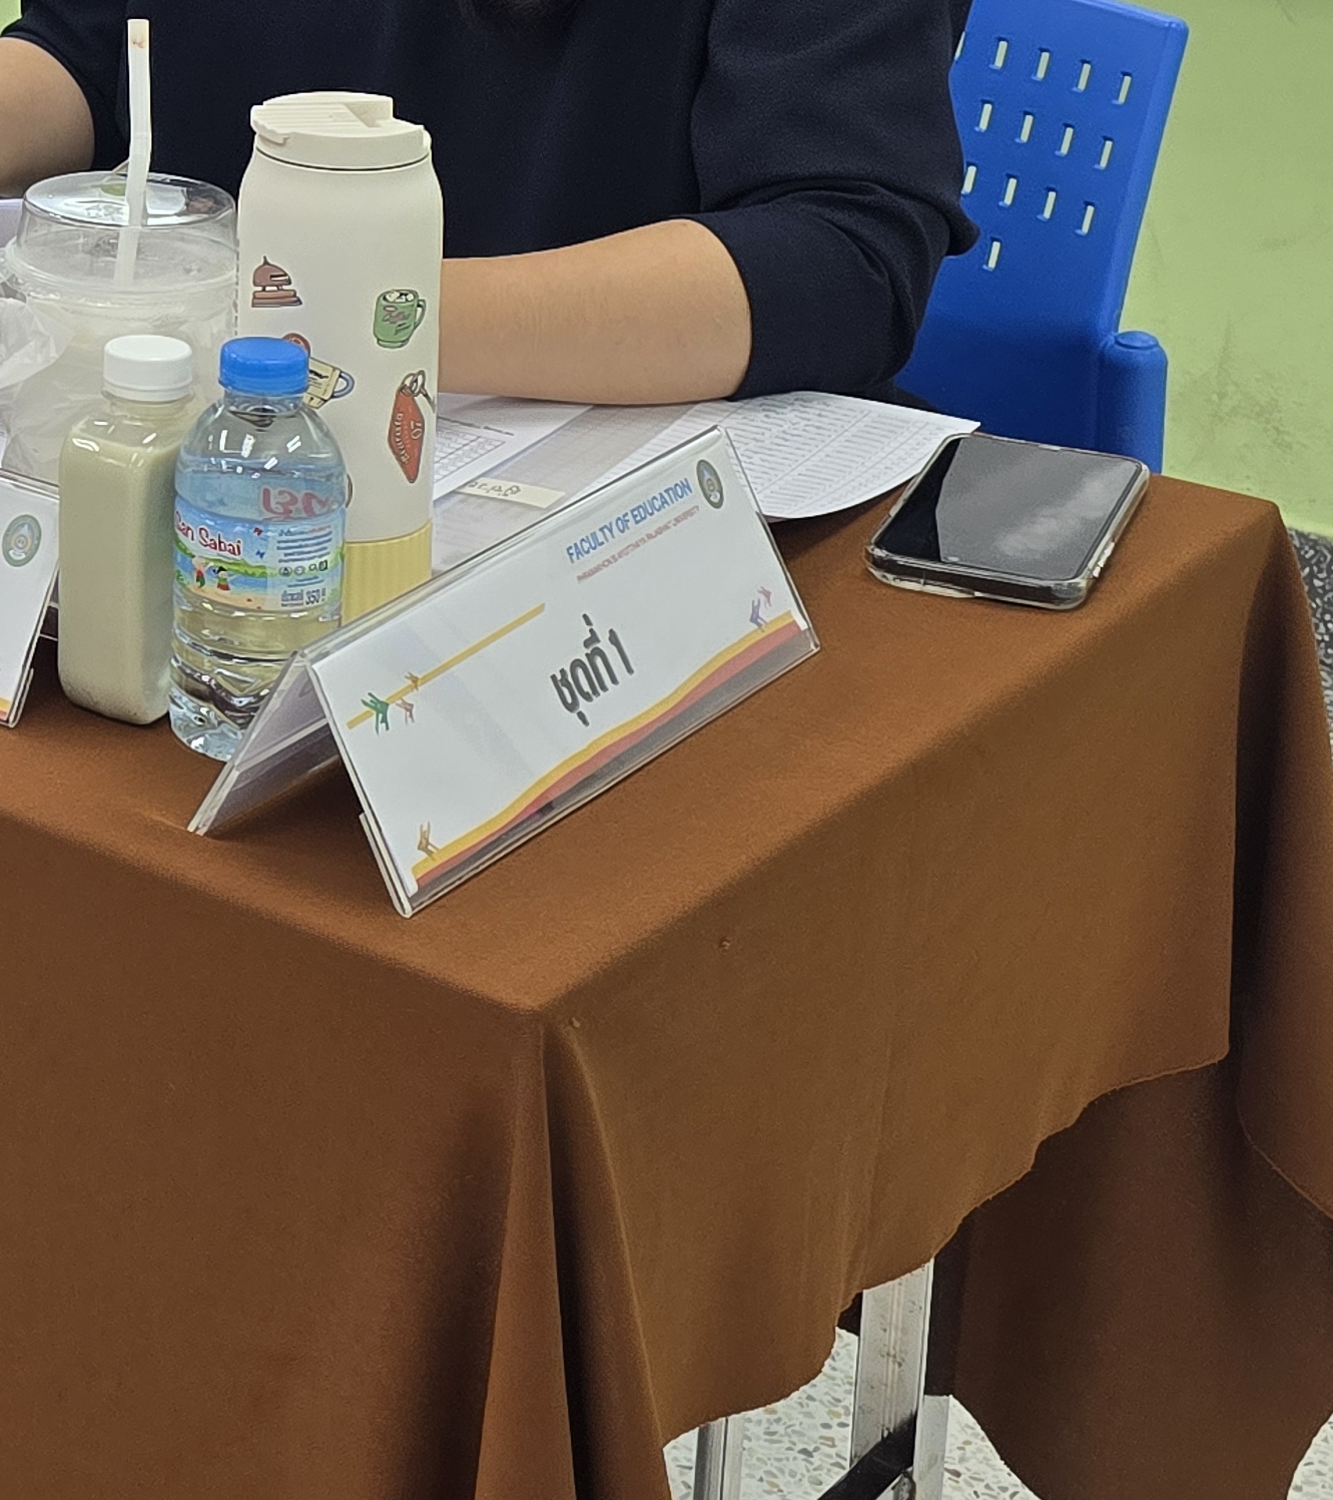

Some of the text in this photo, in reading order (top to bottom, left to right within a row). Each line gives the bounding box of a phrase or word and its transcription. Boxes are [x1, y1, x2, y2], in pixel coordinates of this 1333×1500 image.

[199, 527, 242, 556] Sabai
[566, 522, 615, 564] FACULTY
[615, 512, 631, 534] OF
[630, 478, 693, 525] EDUCATION
[550, 613, 620, 727] ชุดที่
